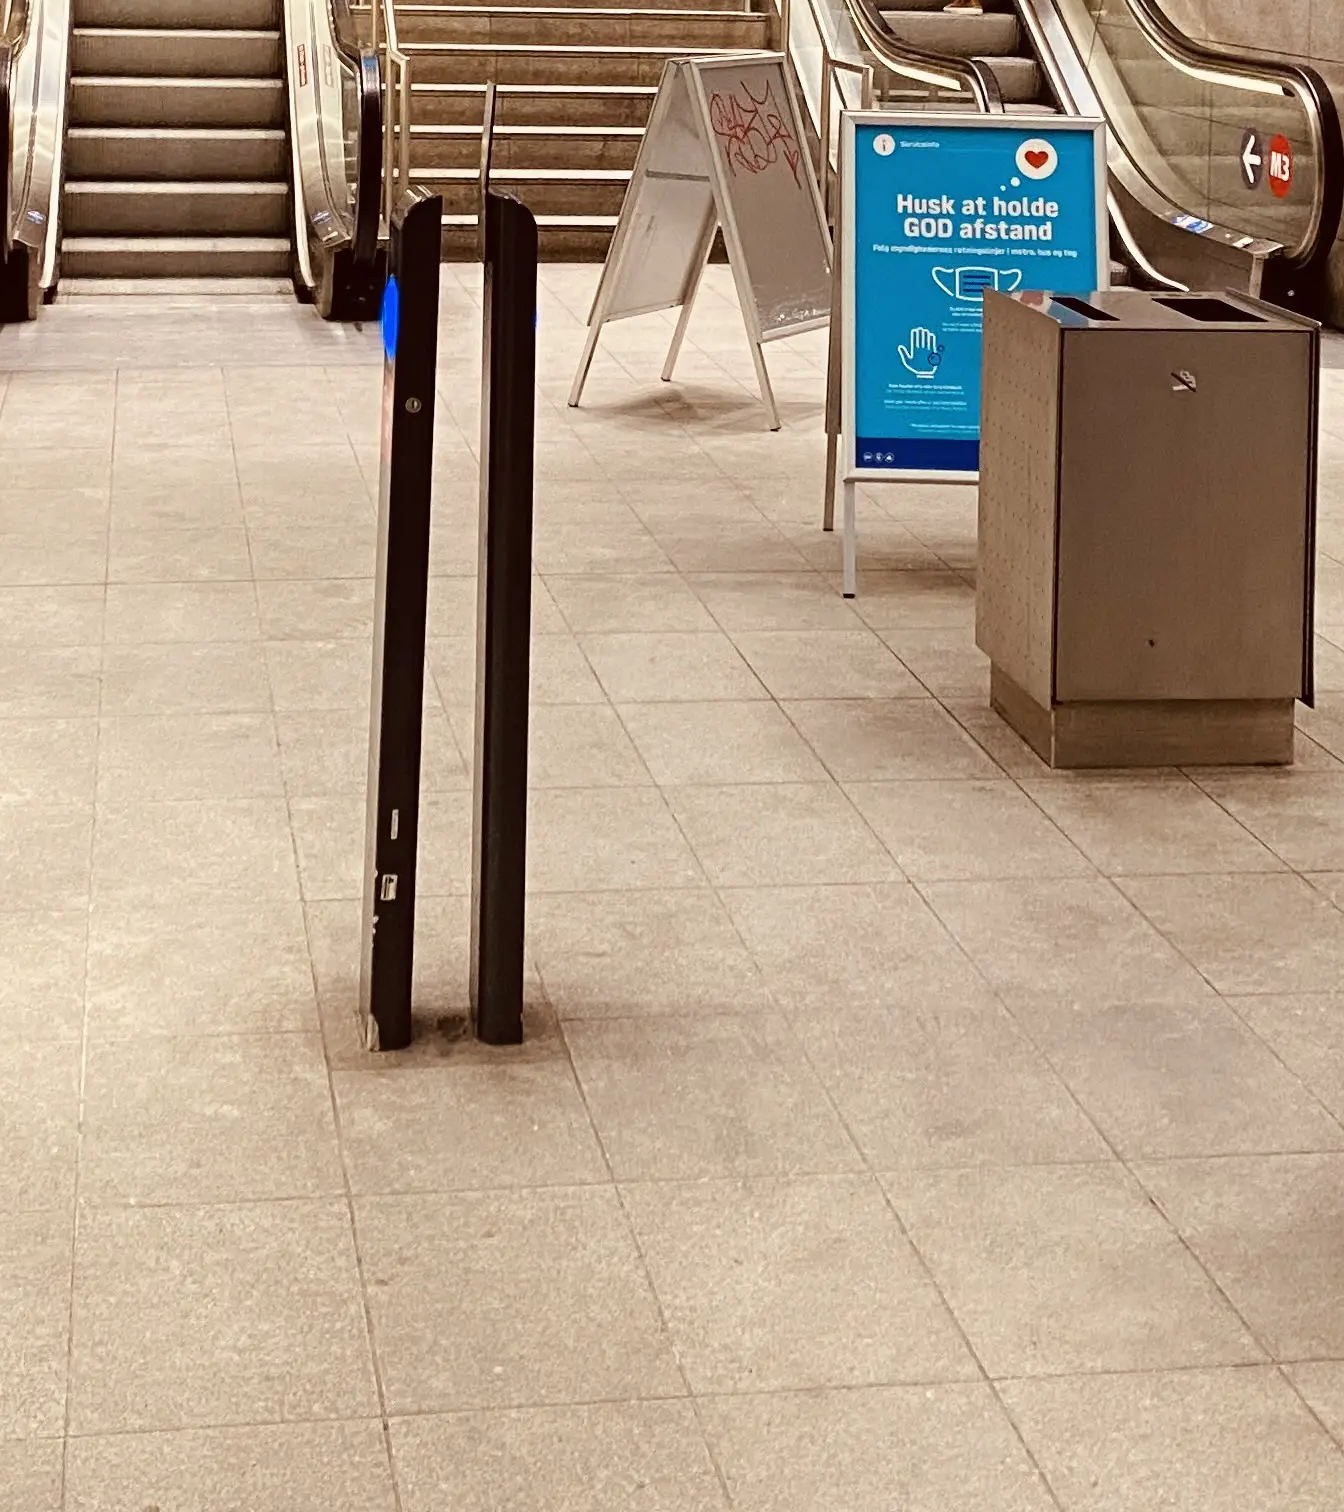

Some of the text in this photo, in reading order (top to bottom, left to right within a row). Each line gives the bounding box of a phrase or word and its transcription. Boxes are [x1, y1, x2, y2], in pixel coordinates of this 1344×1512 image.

[1270, 151, 1290, 182] M3
[896, 193, 1059, 218] Husk at holde
[904, 218, 1052, 240] GOD afstand
